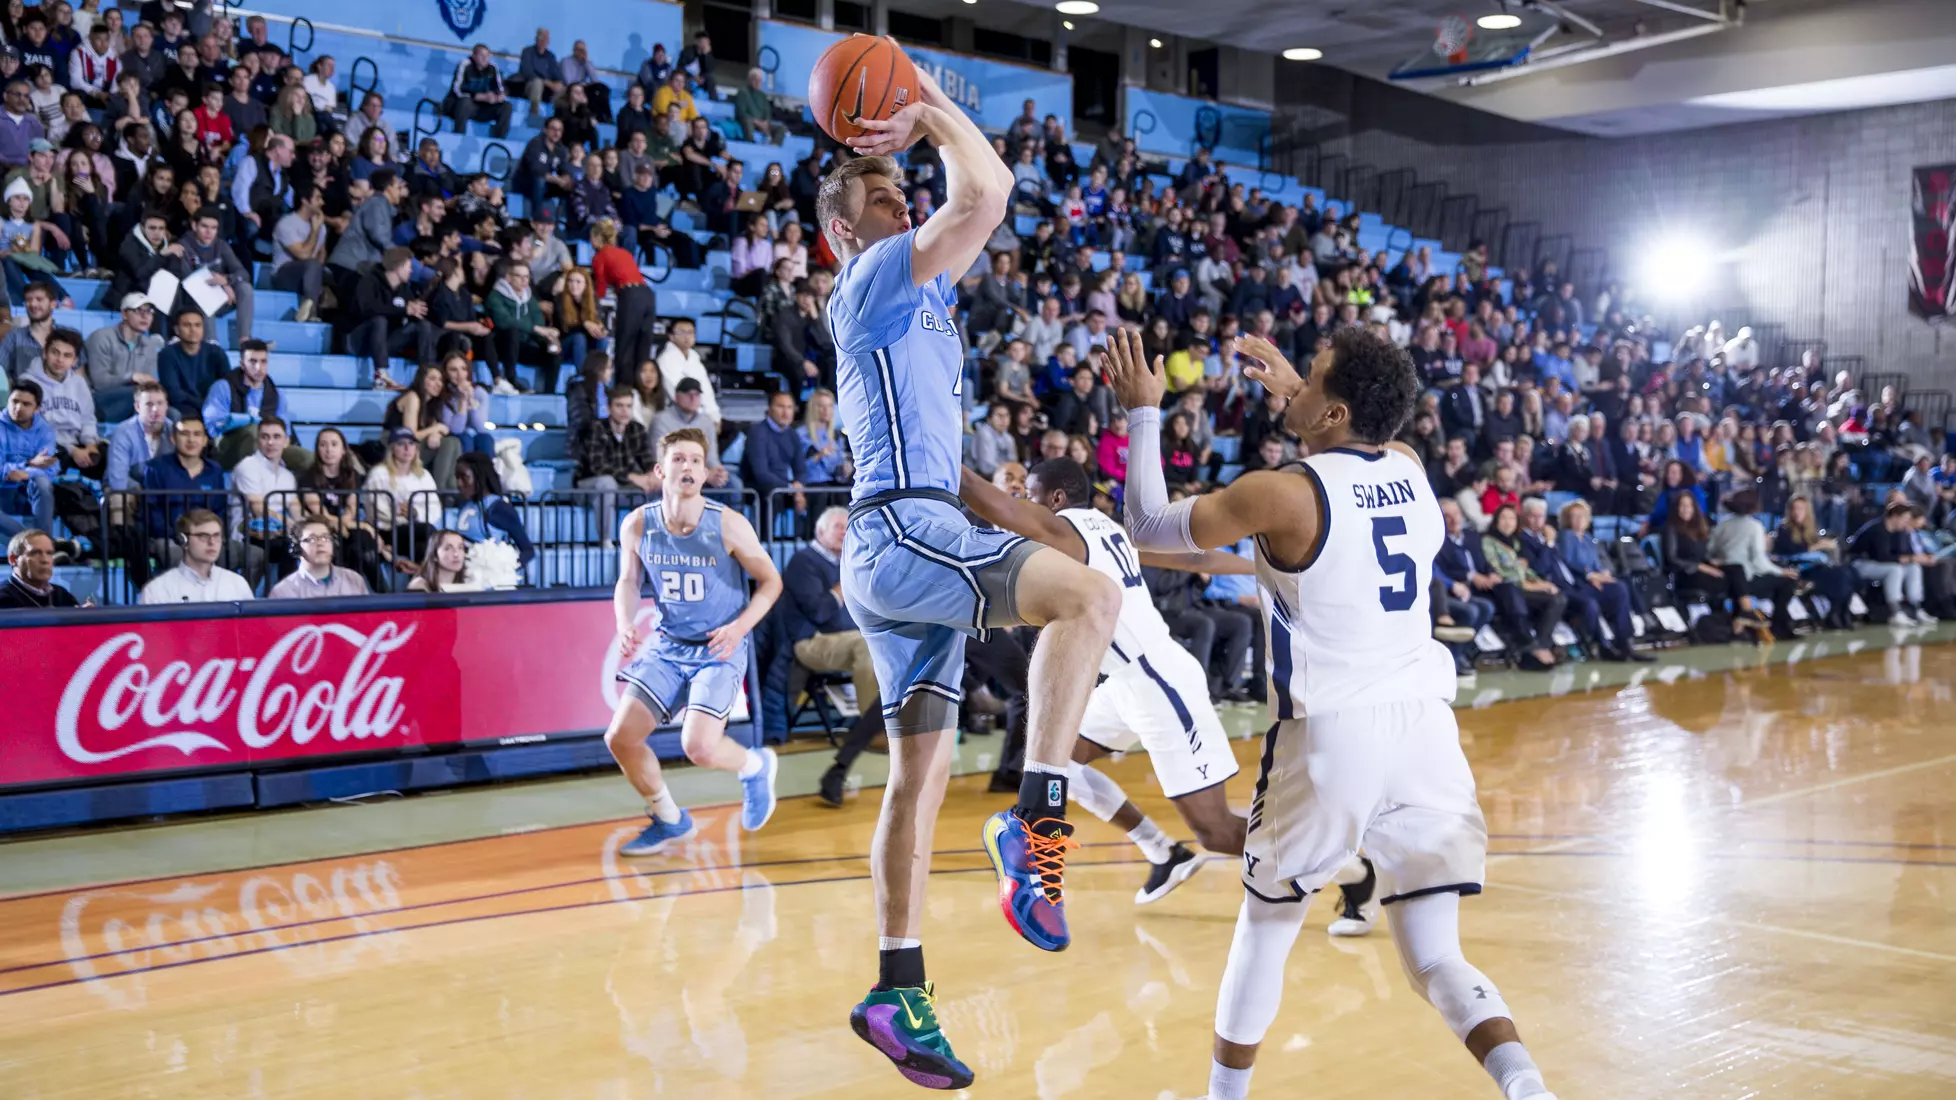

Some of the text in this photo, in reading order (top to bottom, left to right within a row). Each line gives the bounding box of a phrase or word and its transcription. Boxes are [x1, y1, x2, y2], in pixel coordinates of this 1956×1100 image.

[916, 60, 982, 112] MBIA
[1352, 479, 1416, 509] SWAIN
[646, 553, 717, 568] COLUMBIA
[1101, 533, 1142, 588] 10
[1370, 516, 1418, 612] 5
[660, 571, 705, 602] 20
[55, 621, 418, 764] Coca-Cola
[1196, 764, 1209, 780] Y
[1245, 851, 1260, 878] Y
